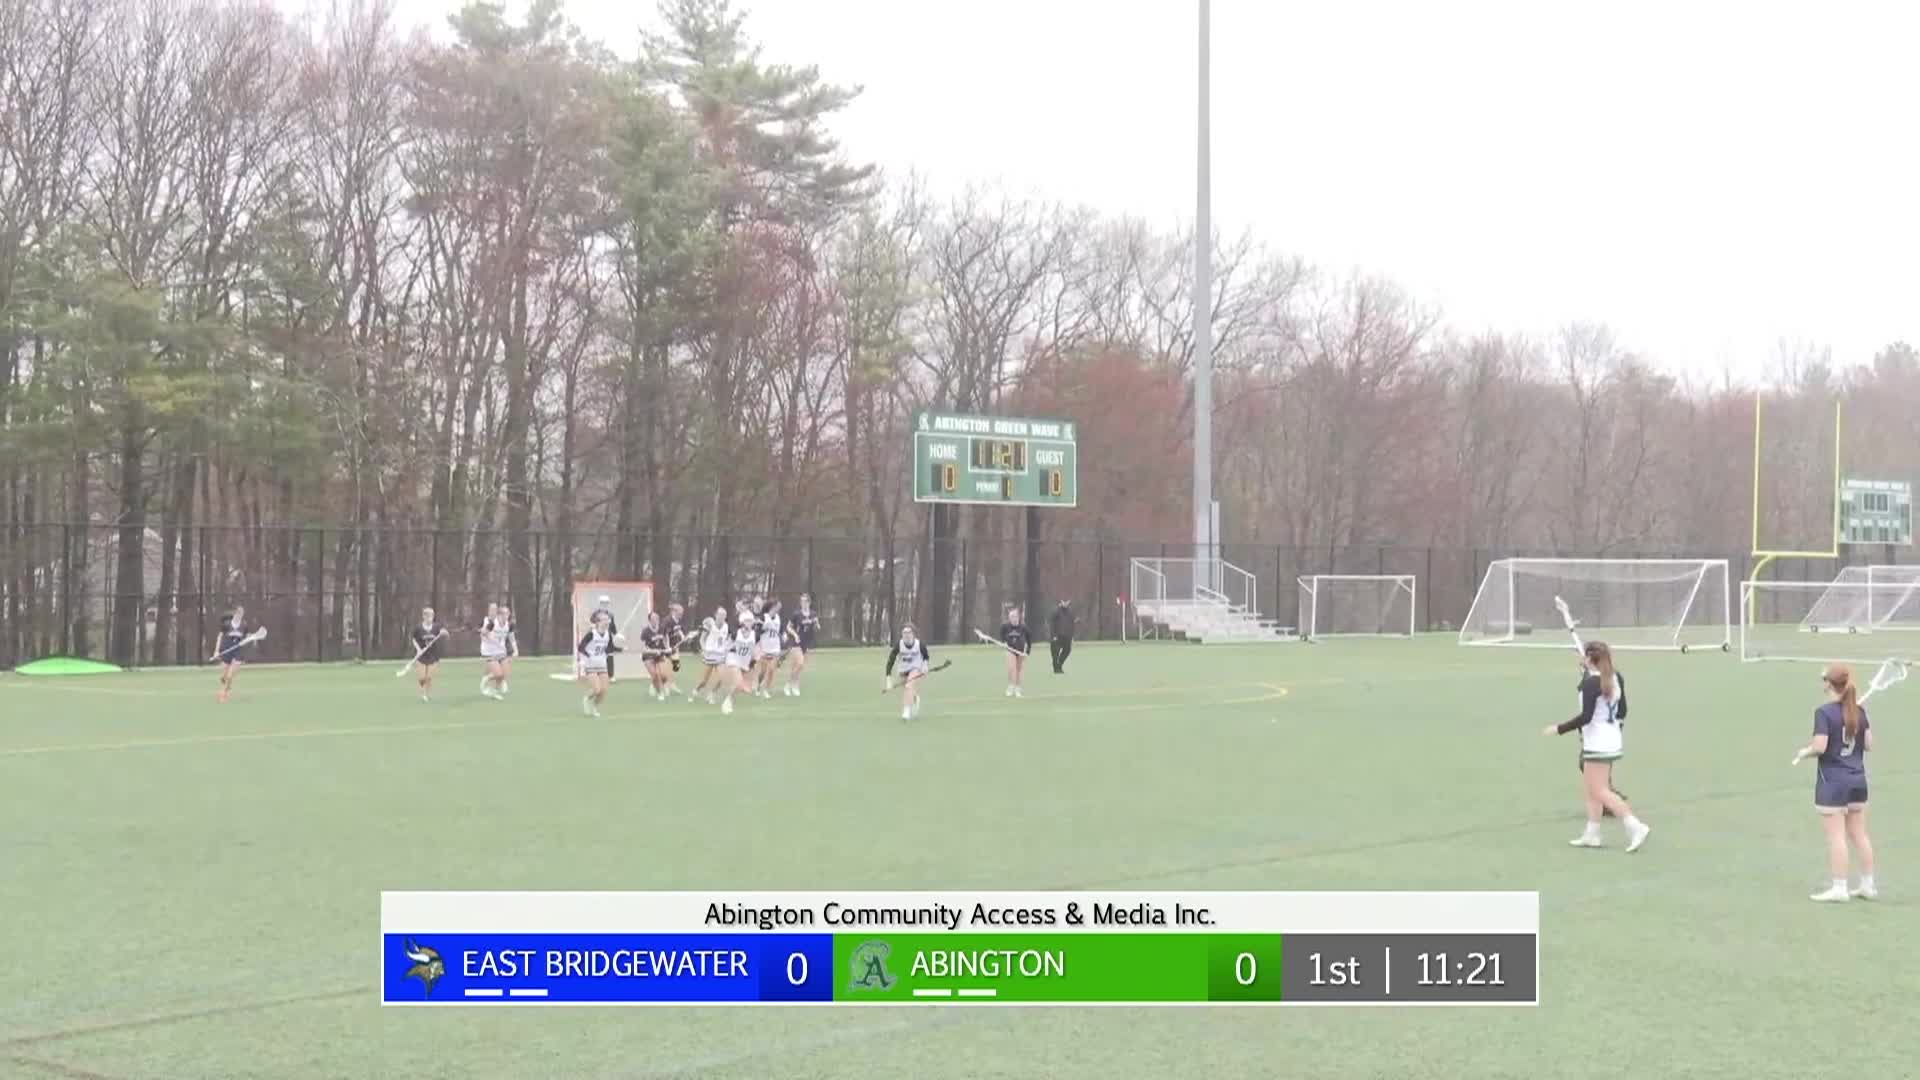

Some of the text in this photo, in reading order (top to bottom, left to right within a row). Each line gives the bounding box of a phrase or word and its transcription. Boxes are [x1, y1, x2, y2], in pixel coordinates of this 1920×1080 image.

[934, 416, 1060, 438] ABINGTON GREEN WAVE
[929, 443, 958, 459] HOME
[1035, 449, 1065, 465] GUEST
